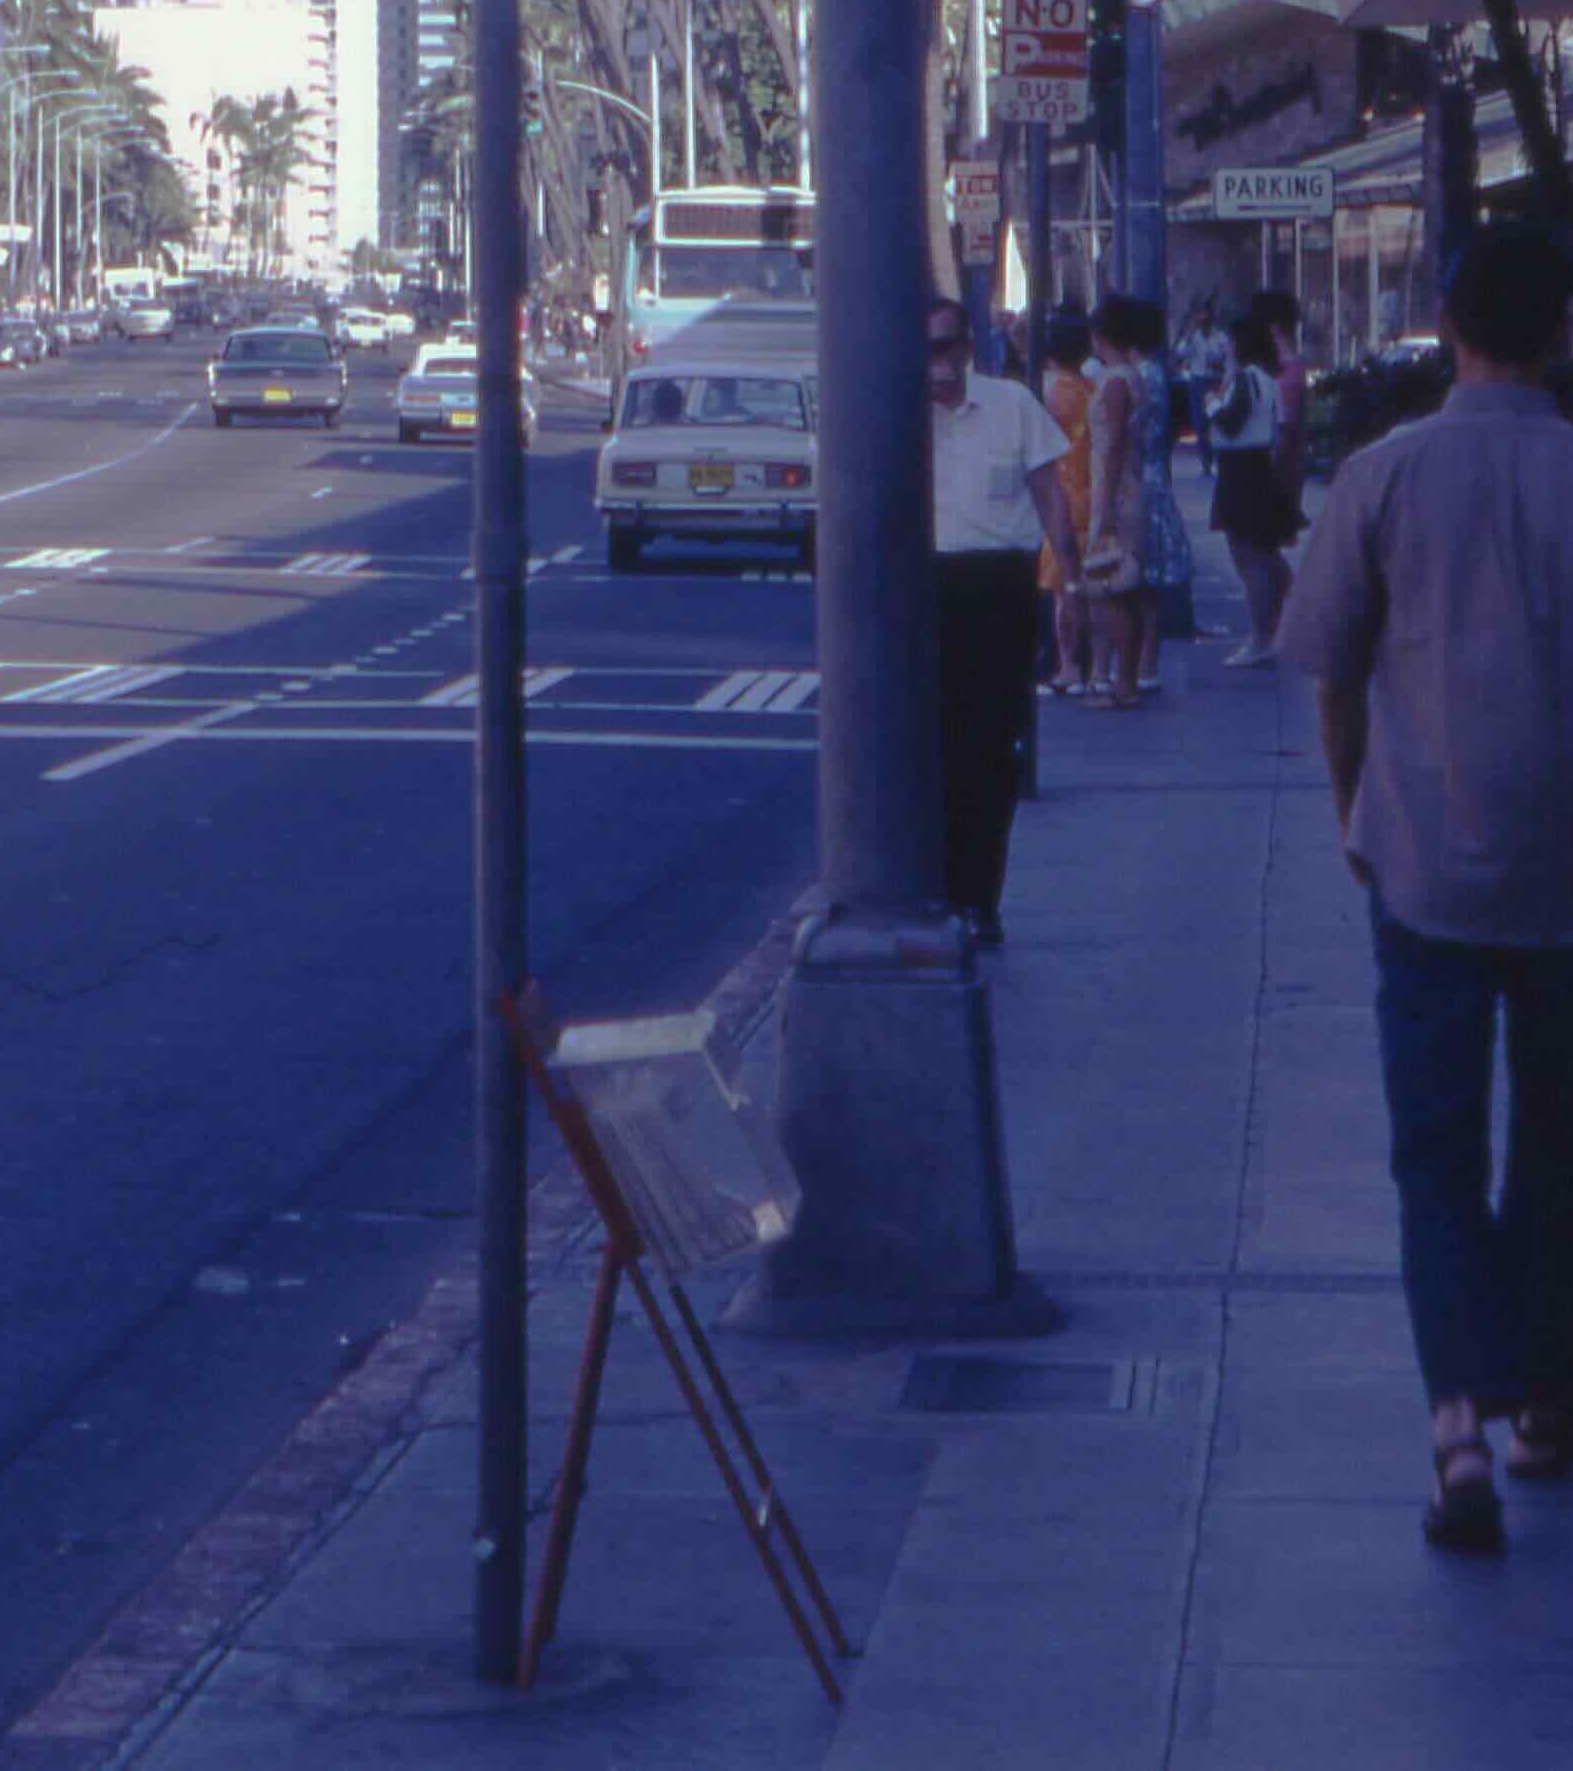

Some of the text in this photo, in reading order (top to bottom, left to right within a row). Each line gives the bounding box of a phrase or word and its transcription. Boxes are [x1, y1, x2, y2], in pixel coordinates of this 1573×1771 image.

[1019, 82, 1069, 100] BUS
[1007, 101, 1078, 119] STOP
[1224, 175, 1324, 199] PARKING
